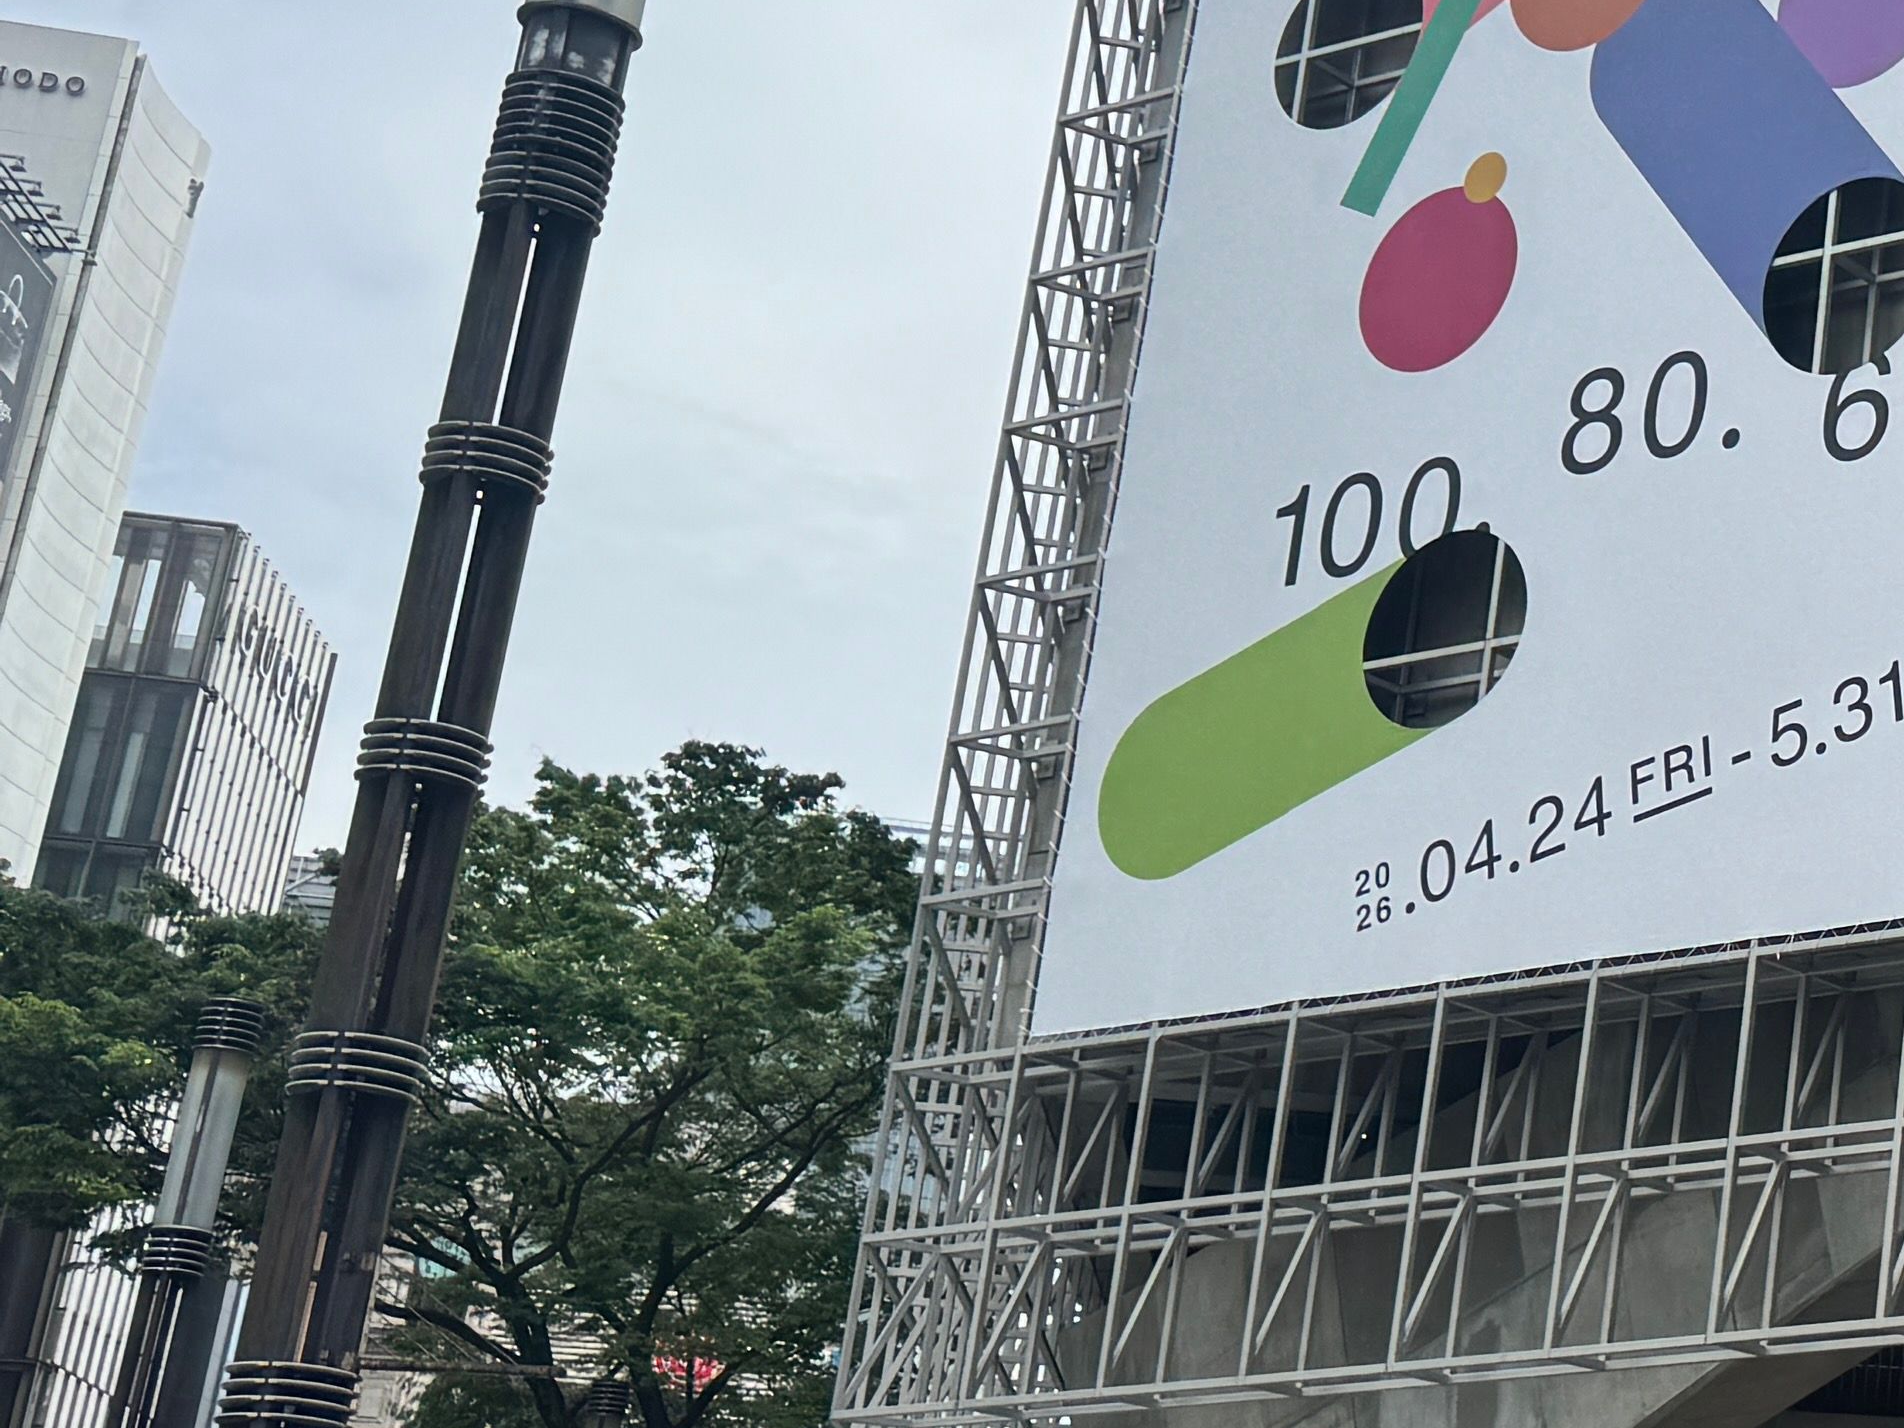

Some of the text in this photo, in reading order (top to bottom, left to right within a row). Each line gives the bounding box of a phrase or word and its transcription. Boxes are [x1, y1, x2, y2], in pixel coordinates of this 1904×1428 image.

[1561, 351, 1742, 475] 80.
[1630, 735, 1712, 805] FRI
[1355, 861, 1391, 897] 20
[1356, 902, 1392, 932] 26
